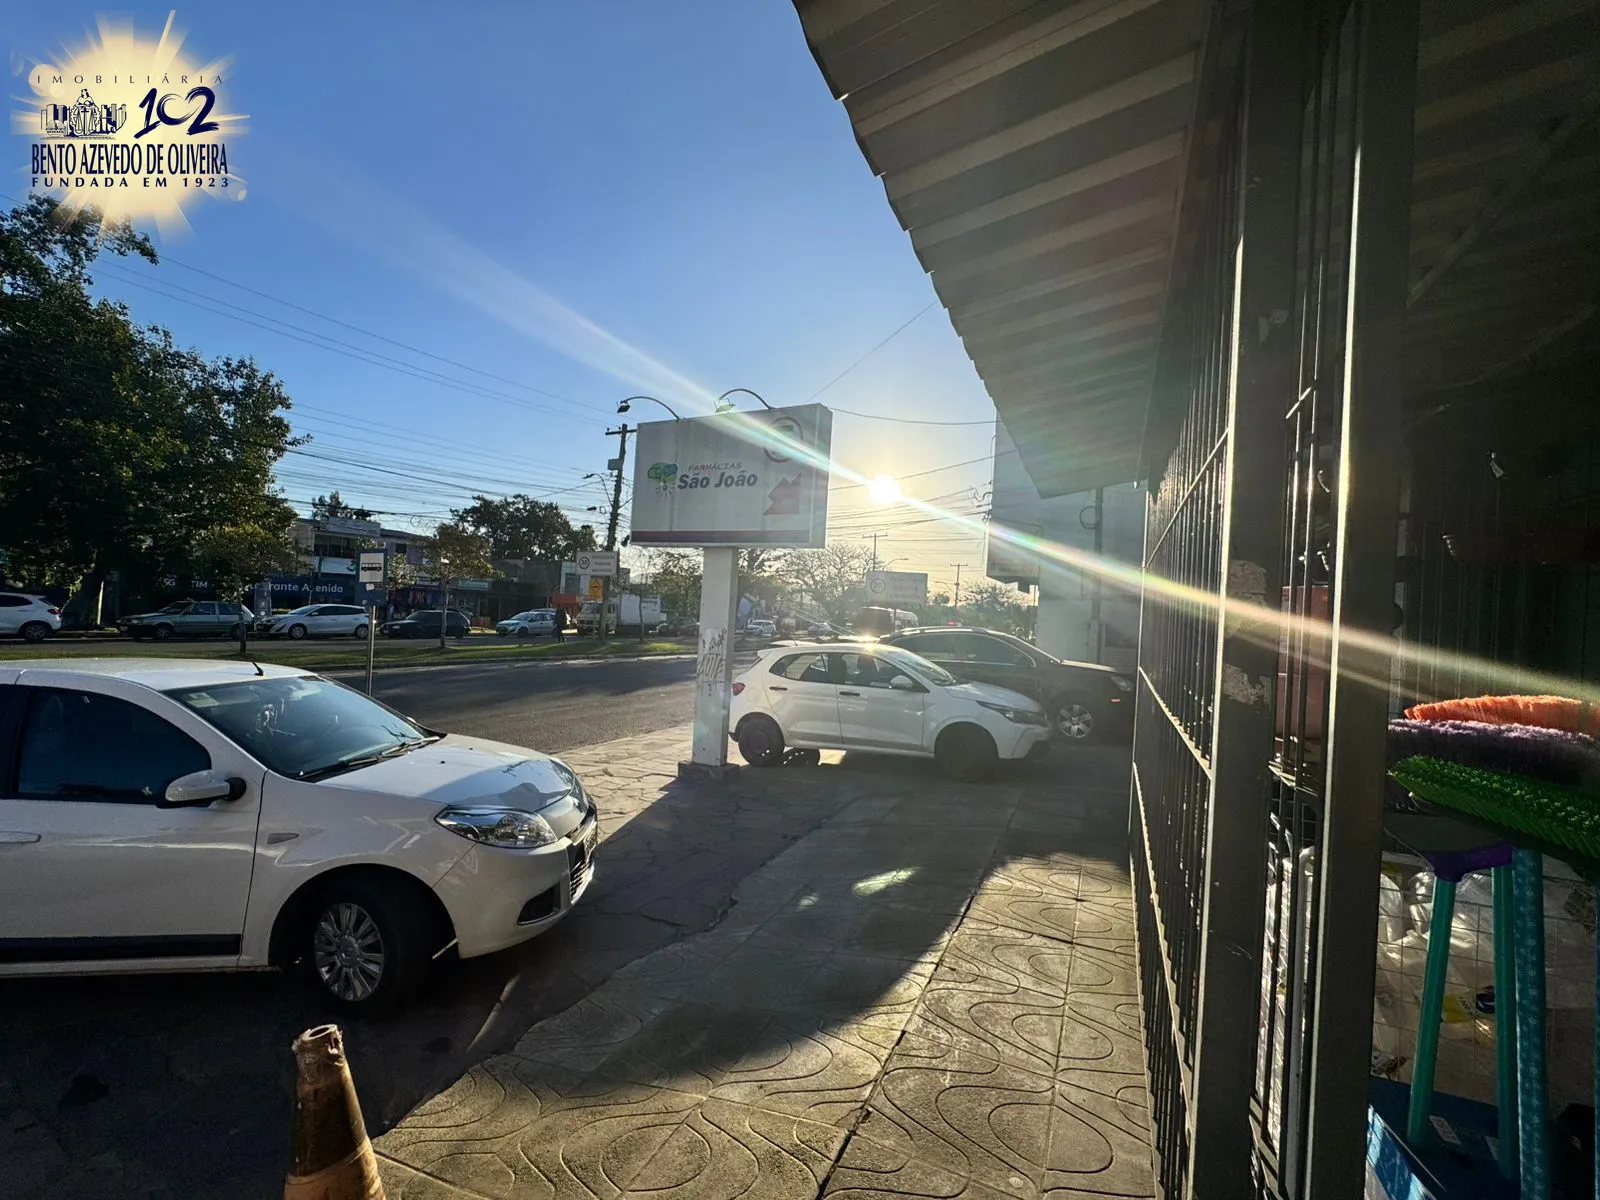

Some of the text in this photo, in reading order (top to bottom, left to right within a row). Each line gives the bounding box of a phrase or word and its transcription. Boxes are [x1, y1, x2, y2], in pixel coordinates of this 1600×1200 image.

[688, 462, 742, 472] FARMÁCIAS
[677, 470, 758, 489] São João
[301, 583, 344, 593] Aenida
